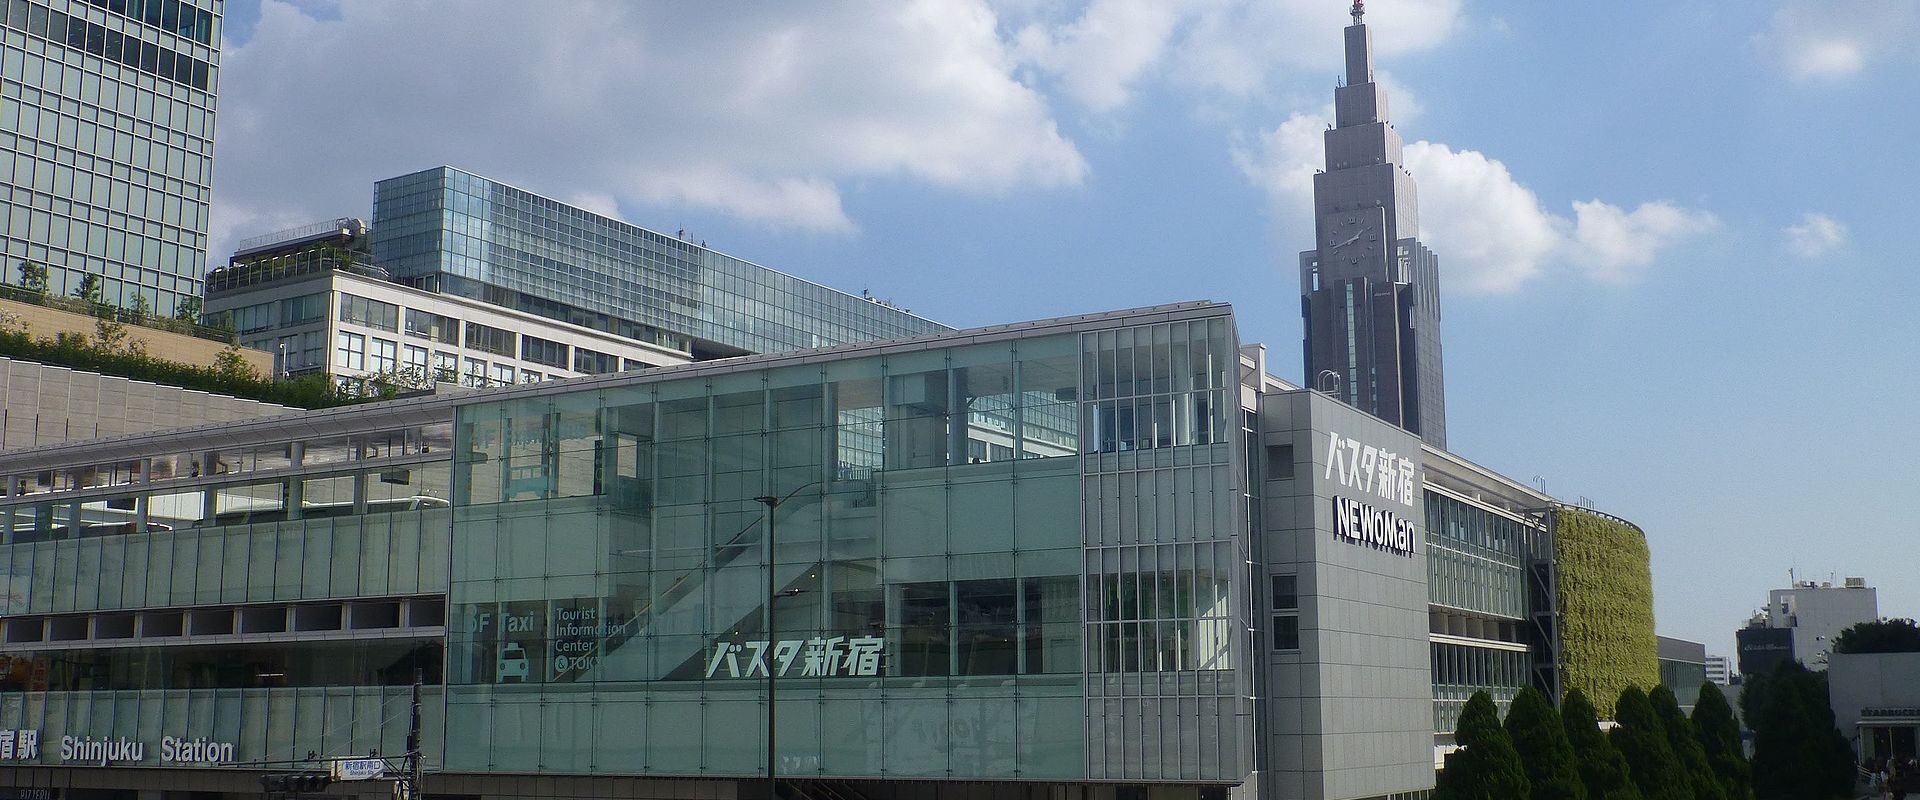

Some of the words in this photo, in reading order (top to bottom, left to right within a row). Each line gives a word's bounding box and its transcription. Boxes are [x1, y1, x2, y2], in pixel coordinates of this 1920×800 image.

[1325, 432, 1415, 506] バスタ新宿
[1336, 495, 1415, 553] NEWoMan
[500, 610, 534, 632] Taxi
[556, 606, 596, 621] Tourist
[556, 622, 626, 636] Informaion
[555, 640, 594, 652] Center
[705, 635, 884, 679] バスタ新宿
[0, 729, 38, 759] 宿駅
[60, 735, 143, 767] Shinjuku
[161, 735, 233, 762] Station
